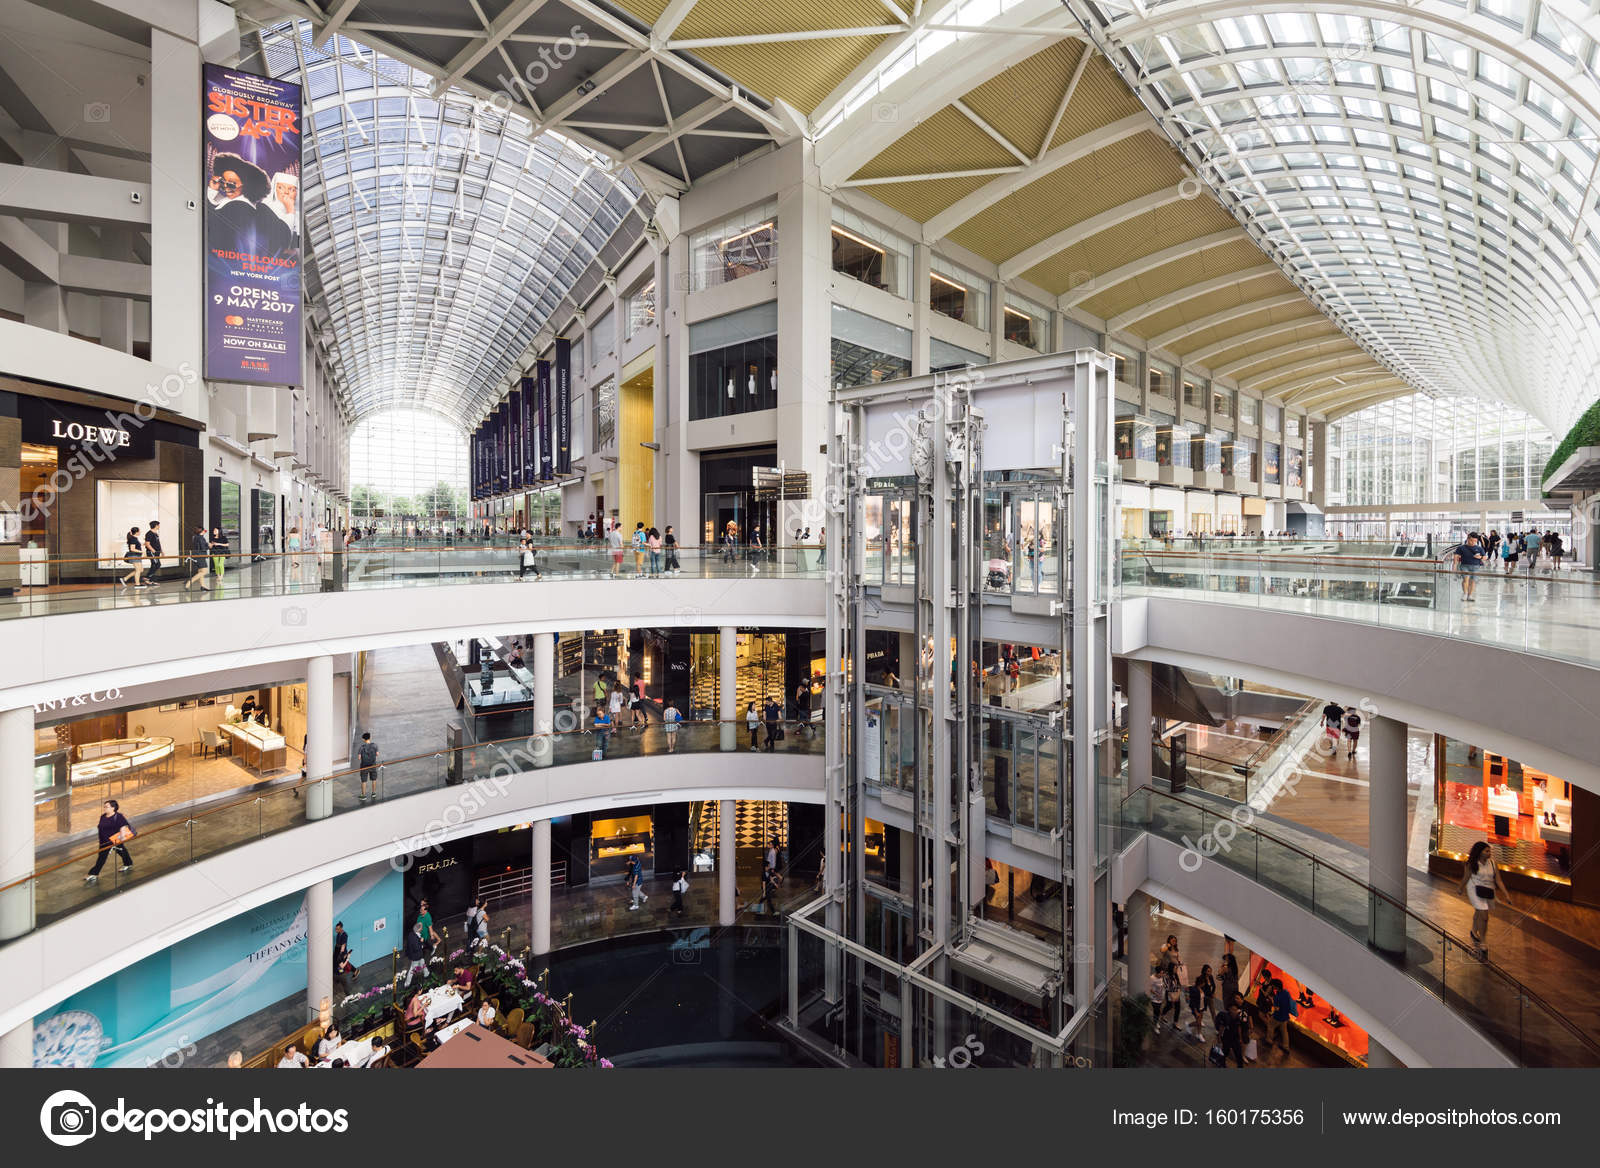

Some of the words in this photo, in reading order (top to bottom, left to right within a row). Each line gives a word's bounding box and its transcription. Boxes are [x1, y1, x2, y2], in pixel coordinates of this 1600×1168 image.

[212, 86, 255, 99] GLORIOUSLY
[256, 96, 294, 109] BROADWAY
[208, 91, 300, 134] SISTER
[240, 118, 289, 144] ACT
[230, 285, 279, 301] OPENS
[214, 294, 224, 305] 9
[227, 296, 258, 309] MAY
[261, 300, 295, 314] 2017
[223, 338, 246, 346] NOW
[247, 340, 261, 348] ON
[262, 342, 286, 351] SALE!
[52, 419, 130, 447] LOEWE
[418, 857, 459, 875] PRADA
